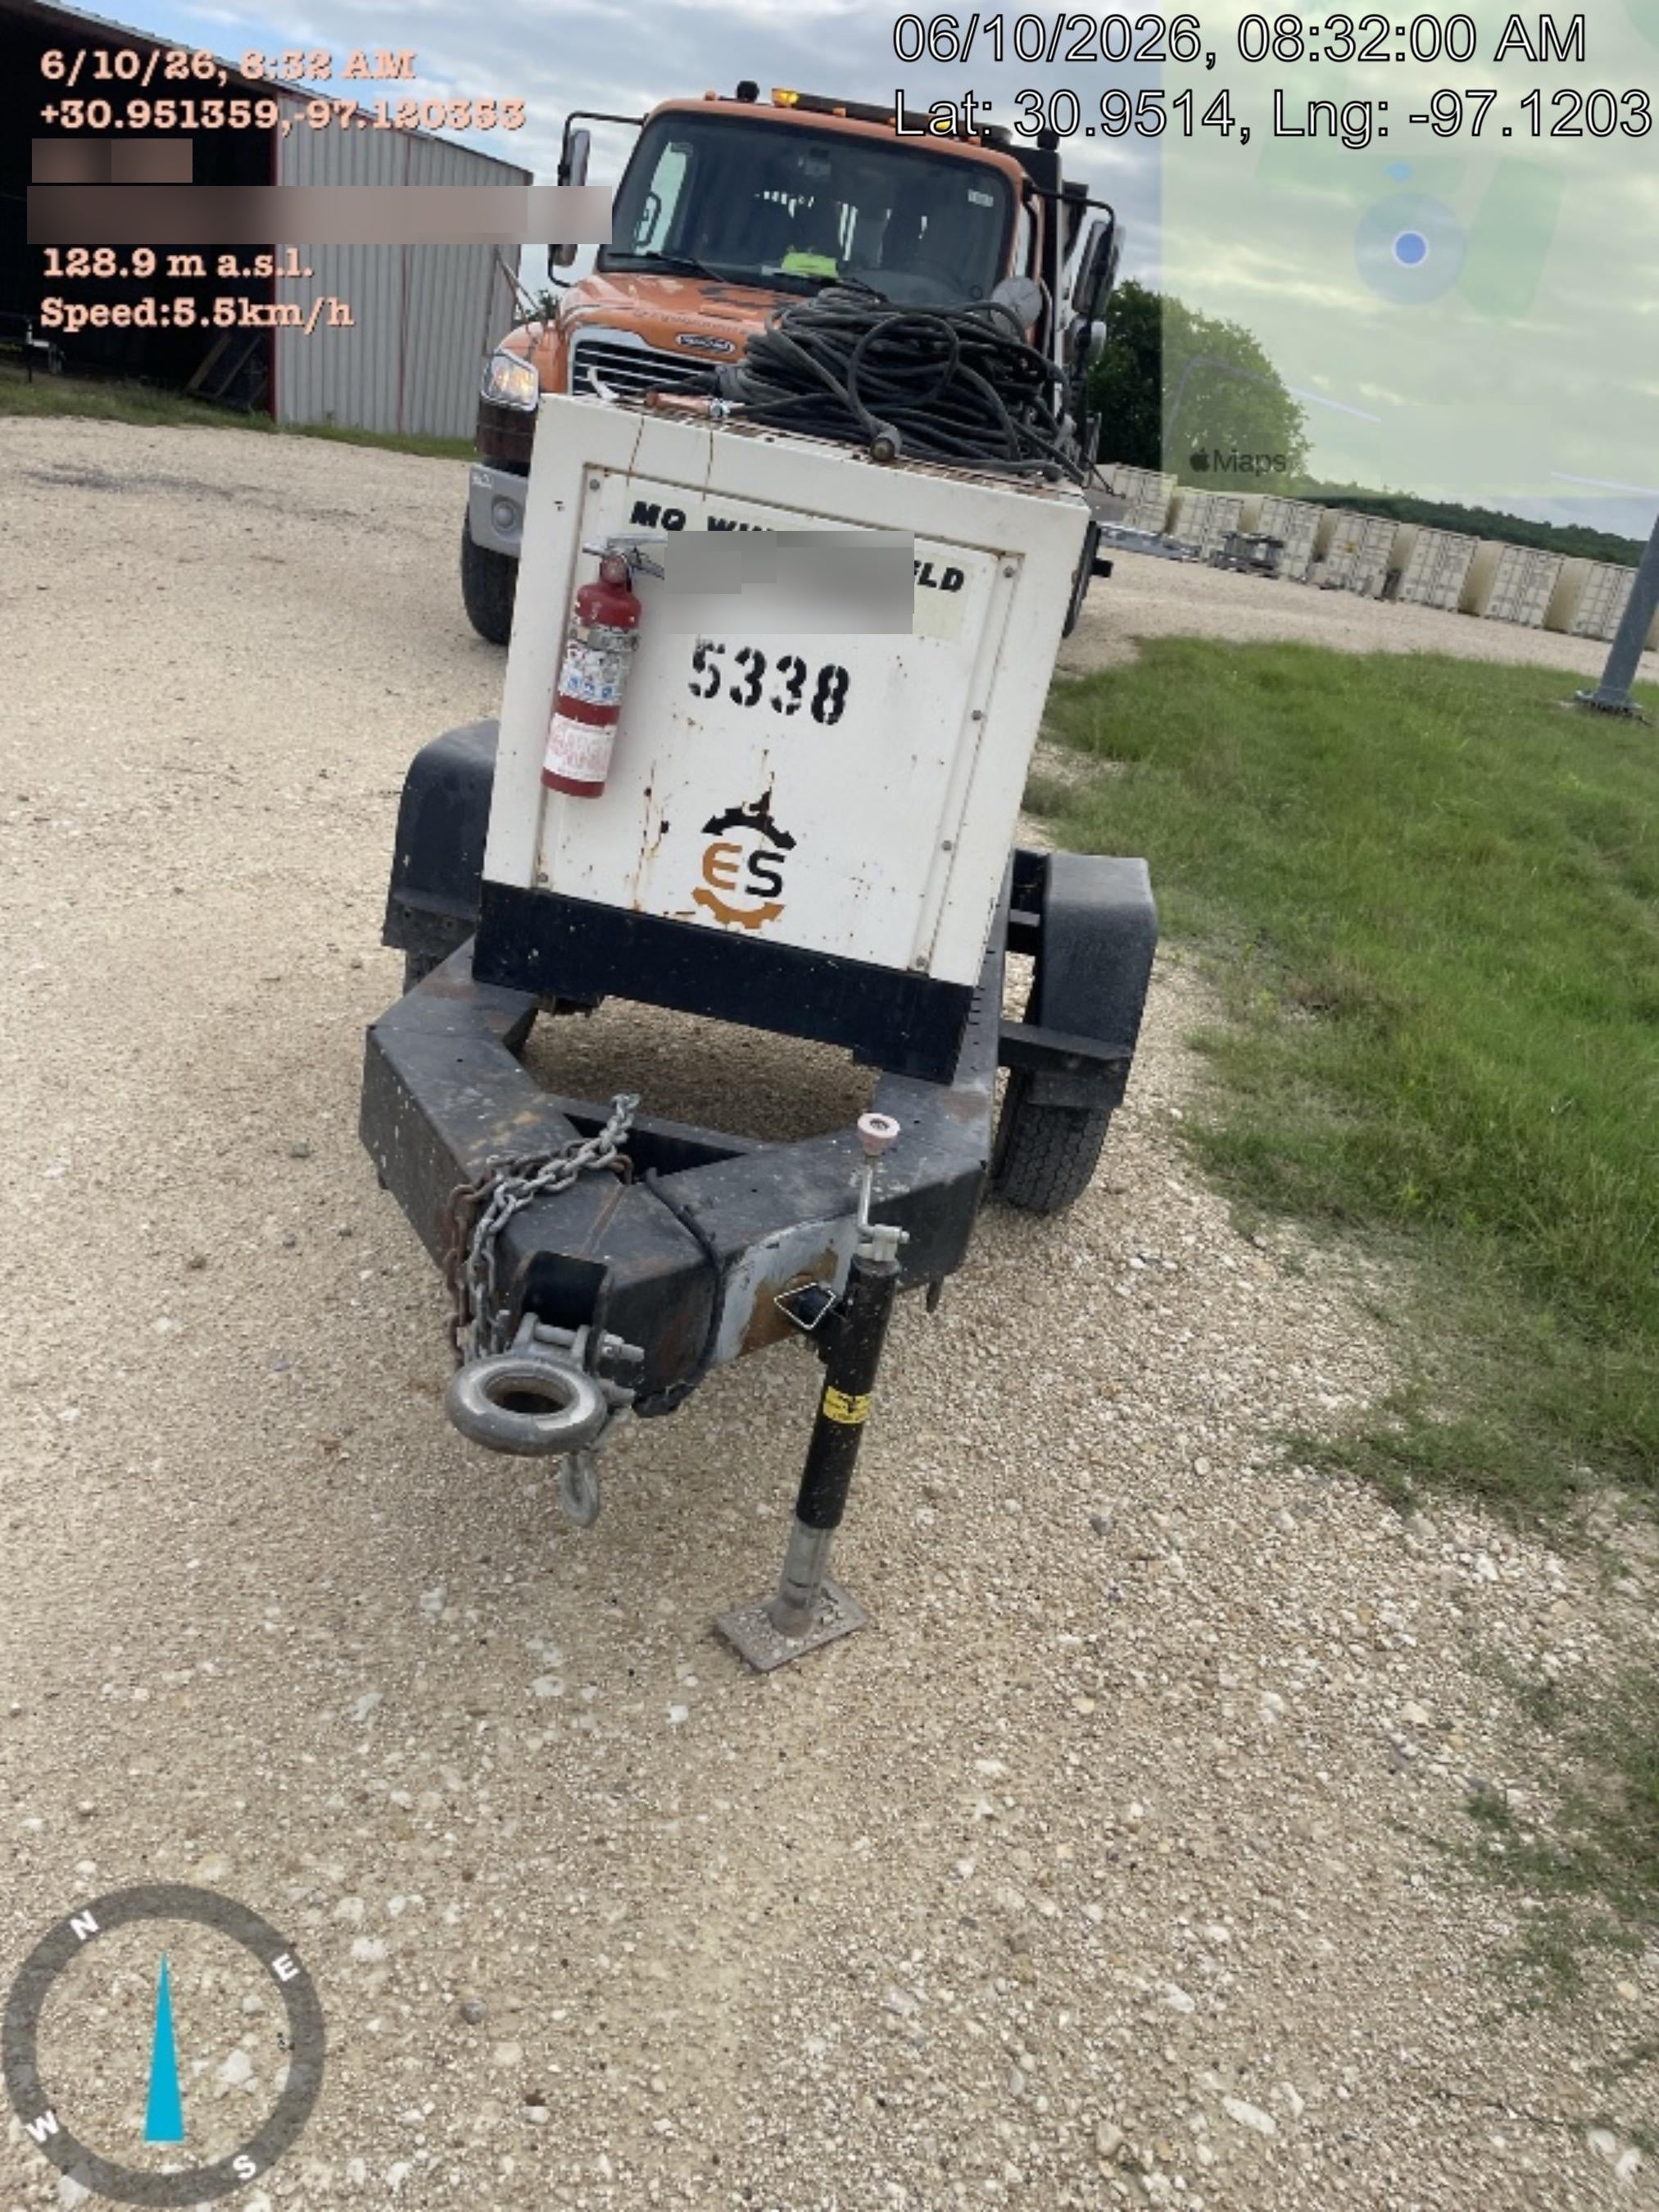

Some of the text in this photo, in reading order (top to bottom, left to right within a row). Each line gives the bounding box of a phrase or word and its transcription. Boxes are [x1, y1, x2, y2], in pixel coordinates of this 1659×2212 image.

[629, 500, 687, 532] MQ
[689, 642, 850, 726] 5338
[702, 842, 785, 897] ES
